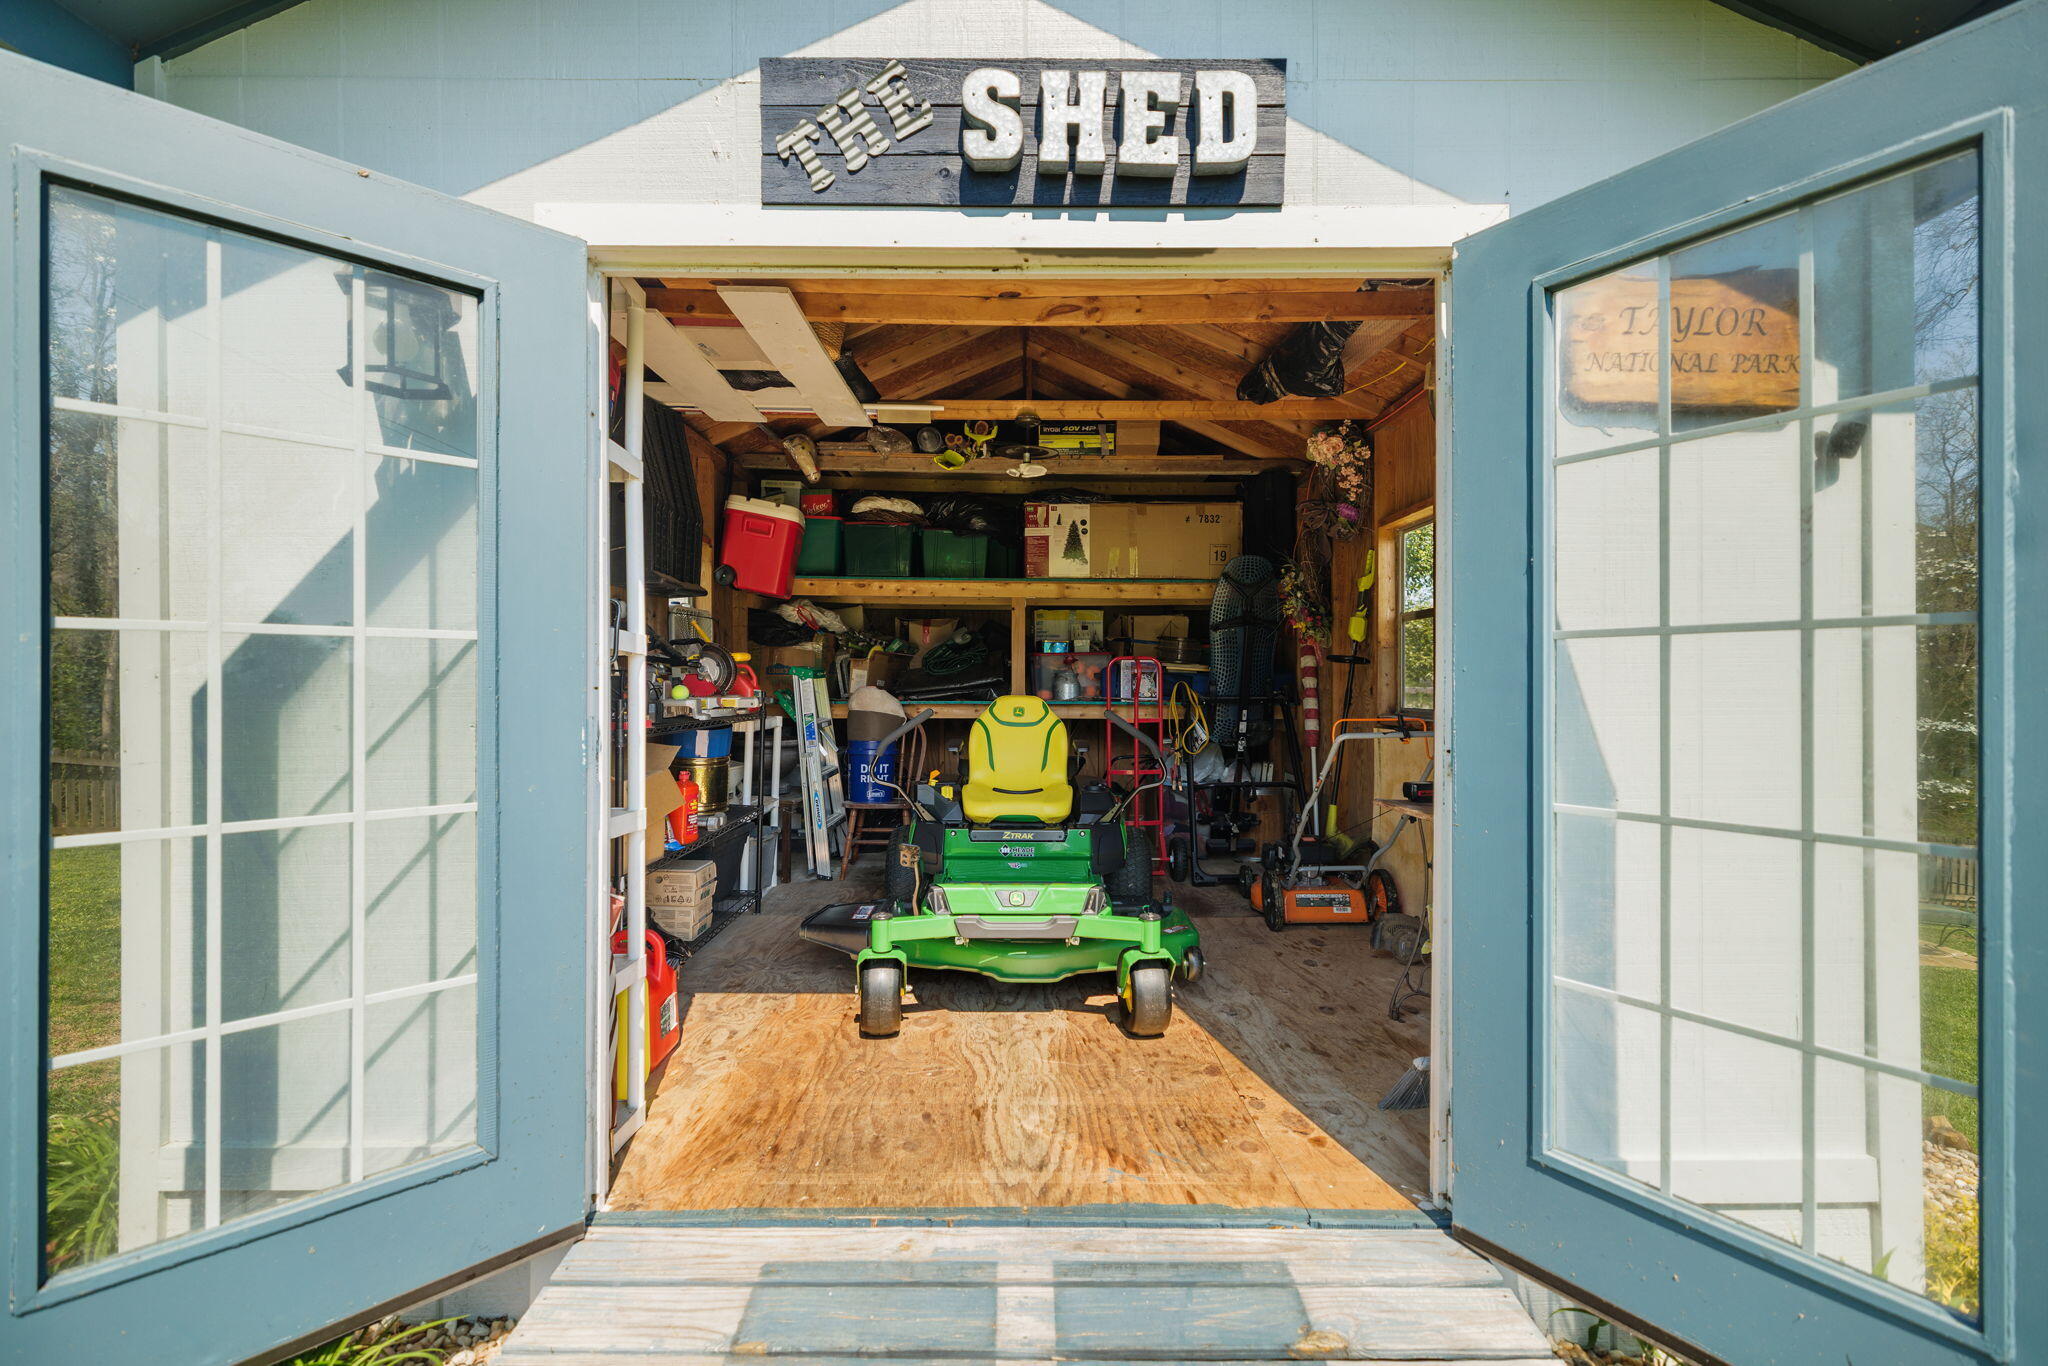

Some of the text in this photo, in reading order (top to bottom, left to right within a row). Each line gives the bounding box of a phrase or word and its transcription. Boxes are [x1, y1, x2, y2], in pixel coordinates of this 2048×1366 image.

[776, 59, 1258, 192] THE SHED
[1730, 352, 1801, 374] PARK
[1198, 514, 1221, 524] 7832
[1214, 550, 1227, 562] 19
[860, 763, 889, 774] D IT
